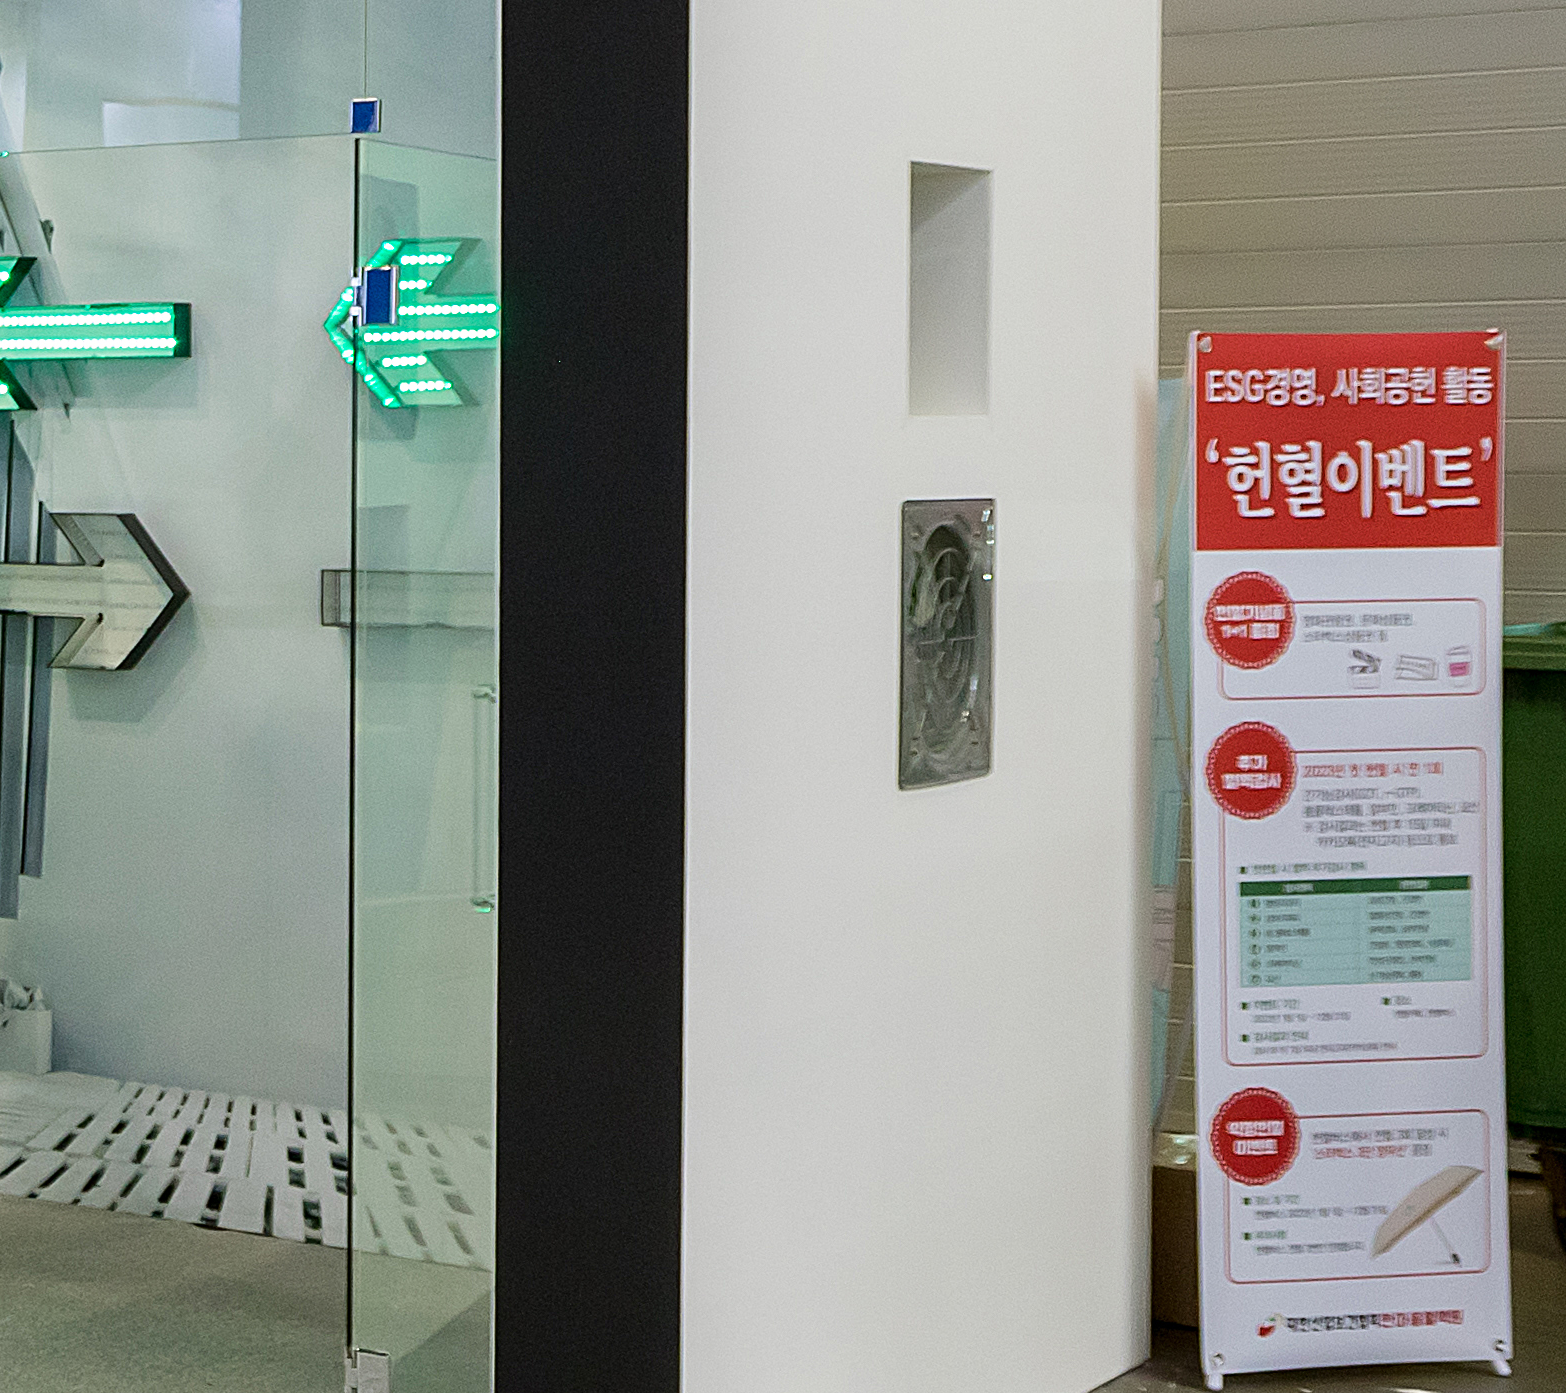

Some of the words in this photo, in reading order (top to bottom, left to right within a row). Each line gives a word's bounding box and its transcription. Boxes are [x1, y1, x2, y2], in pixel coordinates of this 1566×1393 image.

[1204, 367, 1326, 408] ESG경영,
[1330, 367, 1438, 406] 사회공헌
[1442, 366, 1495, 405] 활동
[1204, 437, 1495, 520] '헌혈이벤트'
